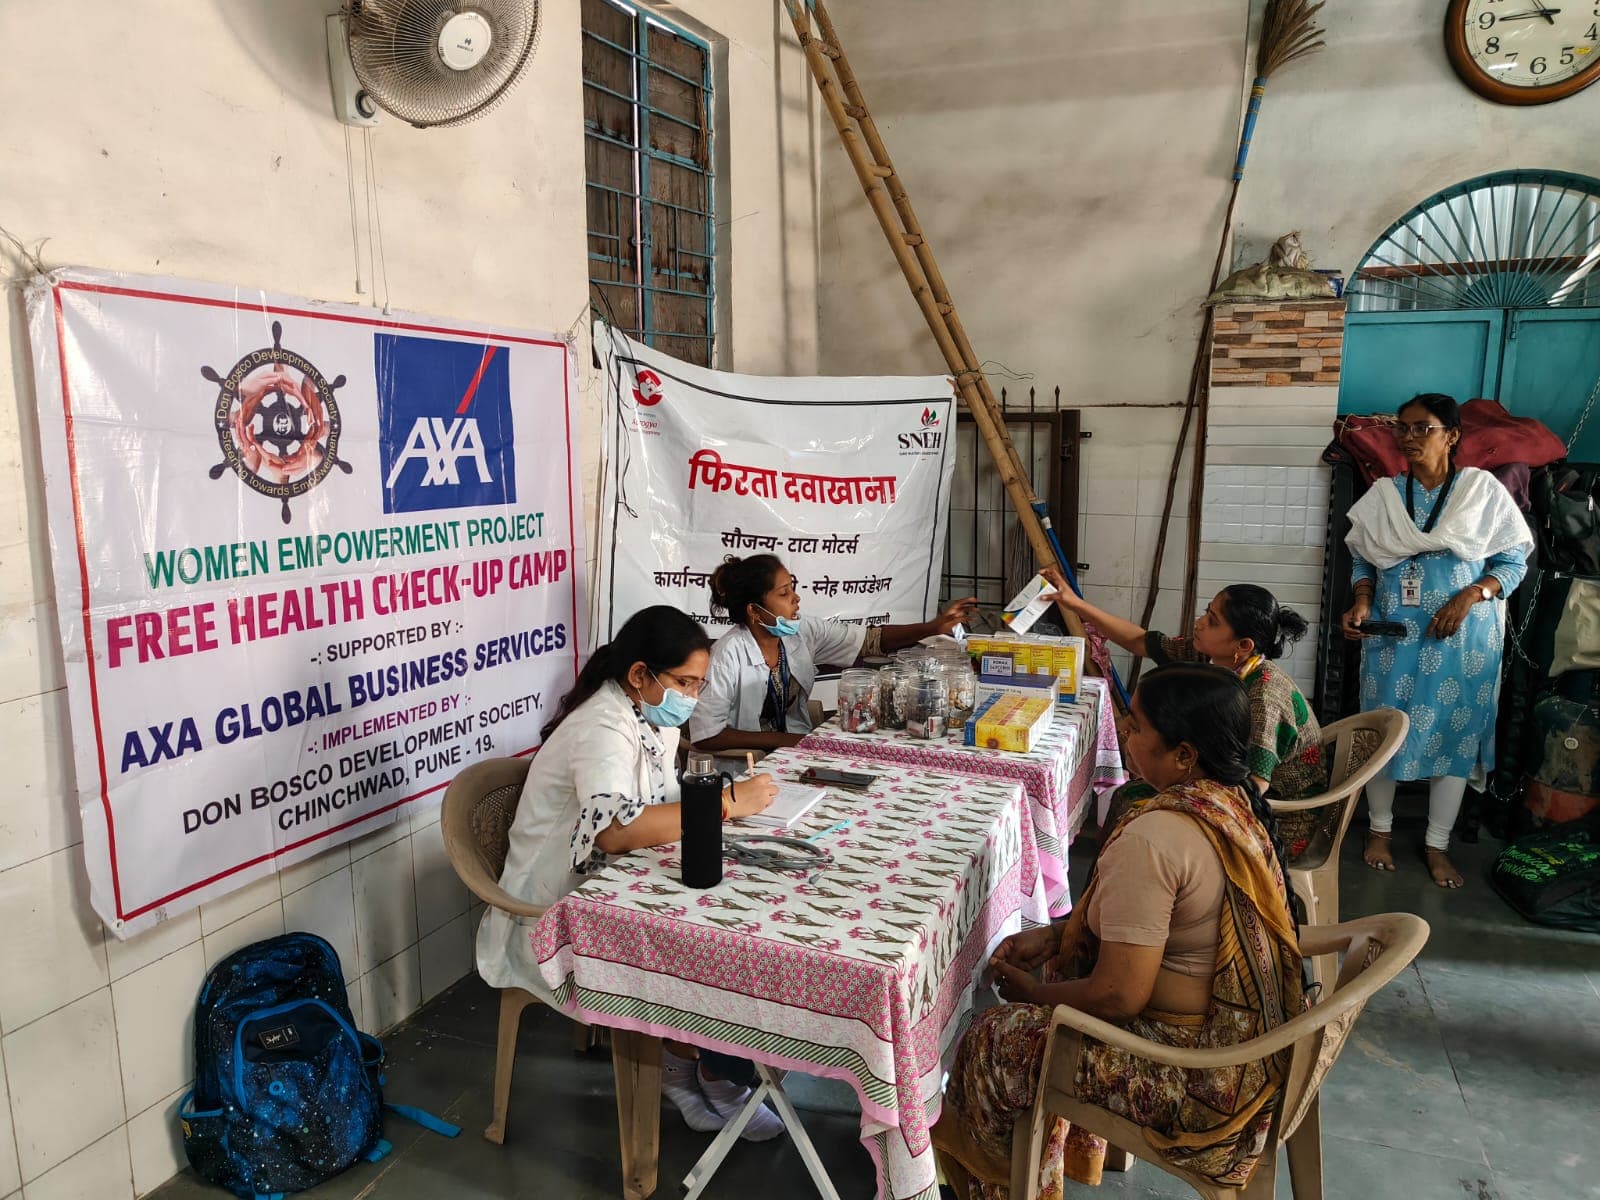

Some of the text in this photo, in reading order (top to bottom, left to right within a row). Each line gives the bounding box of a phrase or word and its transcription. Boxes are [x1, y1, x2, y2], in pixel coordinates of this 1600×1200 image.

[1479, 12, 1496, 30] 9
[1485, 36, 1500, 54] 8
[1584, 22, 1598, 40] 4
[1530, 56, 1547, 75] 6
[1560, 46, 1575, 65] 5
[216, 350, 338, 421] Don Bosco Development Society
[222, 430, 338, 496] Steering towards Empowerment
[386, 417, 493, 488] AXA
[898, 432, 942, 450] SNEH
[688, 448, 896, 504] फिरता दवाखाना
[144, 512, 544, 590] WOMEN EMPOWERMENT PROJECT
[788, 538, 818, 553] टाटा
[822, 533, 860, 554] मोटर्स
[107, 549, 567, 668] FREE HEALTH CHECK-UP CAMP
[653, 566, 713, 588] कार्यान्व
[812, 575, 840, 598] स्नेह
[842, 574, 892, 594] फाउंडेशन
[326, 625, 426, 662] SUPPORTED
[428, 620, 451, 640] BY
[120, 624, 567, 773] AXA GLOBAL BUSINESS SERVICES
[322, 700, 438, 751] IMPLEMENTED
[438, 694, 460, 717] BY
[184, 692, 544, 834] DON BOSCO DEVELOPMENT SOCIETY,
[278, 766, 410, 830] CHINCHWAD,
[414, 745, 462, 780] PUNE
[474, 738, 495, 763] 19.
